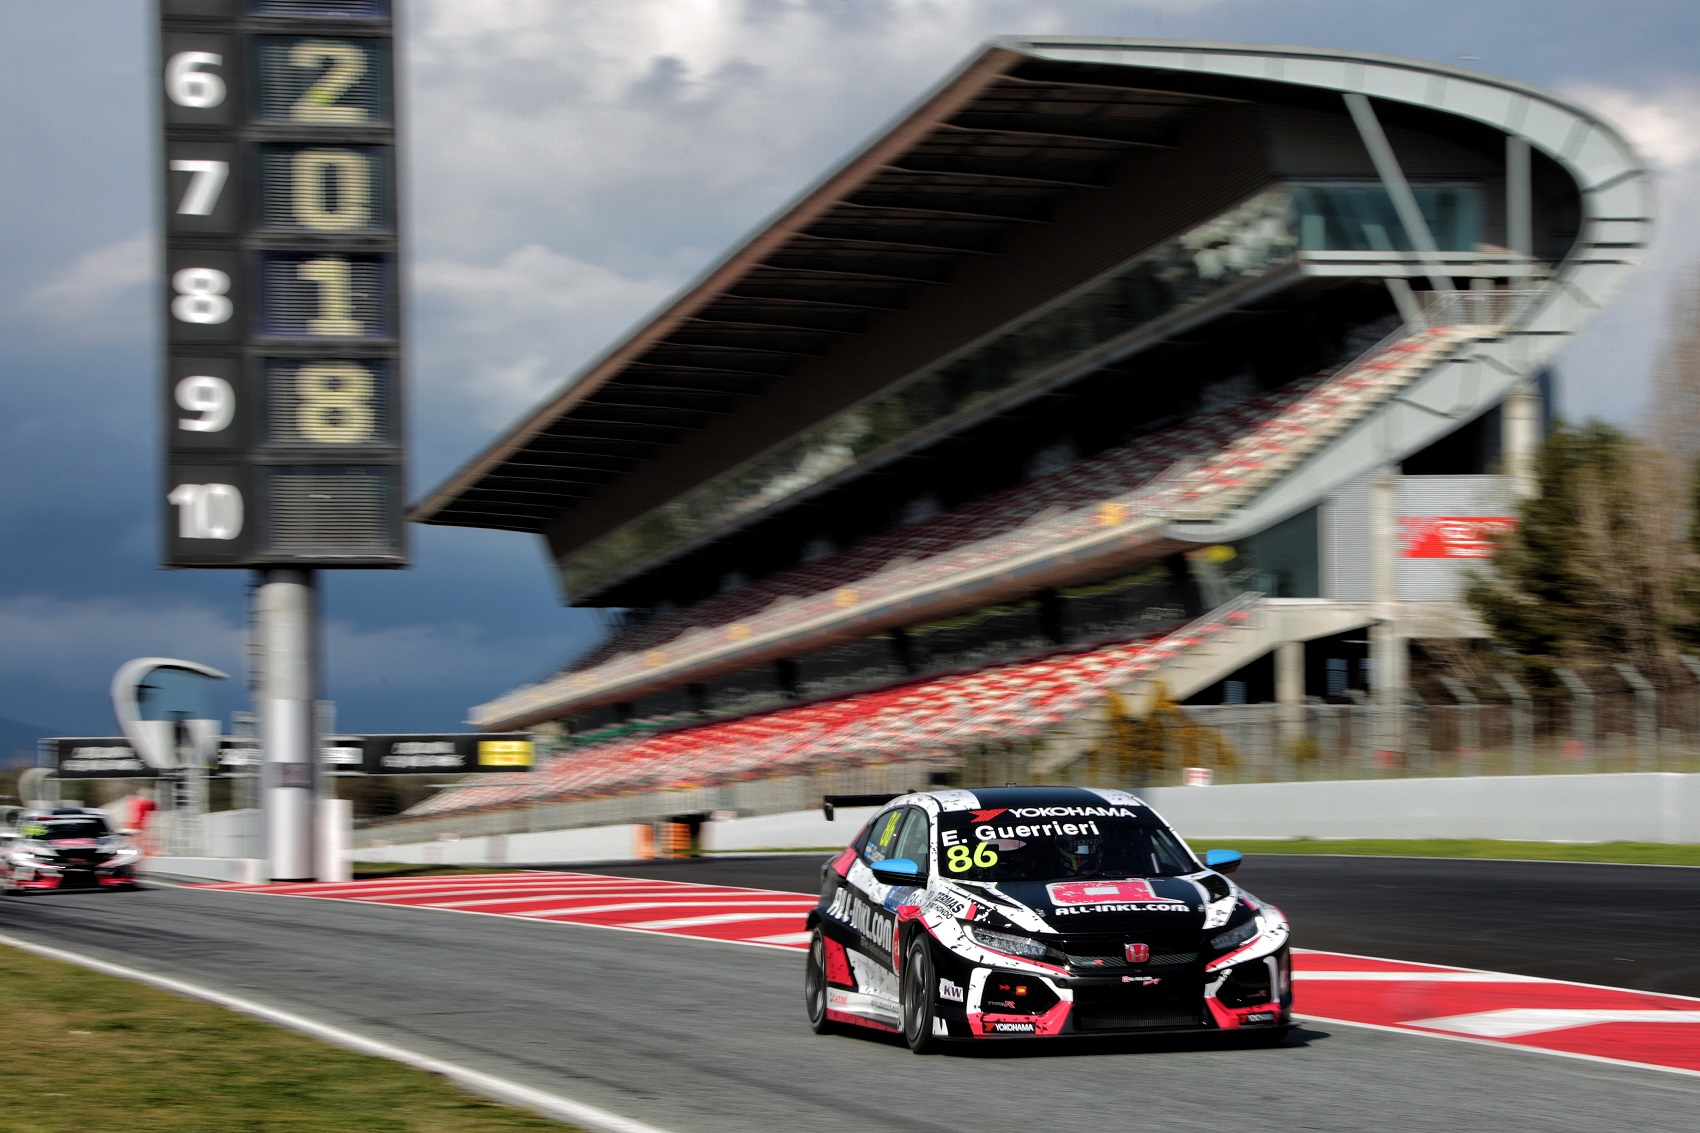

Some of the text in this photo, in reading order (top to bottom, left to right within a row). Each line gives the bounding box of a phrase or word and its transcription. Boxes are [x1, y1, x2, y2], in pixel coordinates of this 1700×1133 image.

[164, 41, 367, 122] 6 2
[169, 148, 370, 230] 7 0
[170, 259, 363, 336] 8 1
[174, 360, 375, 443] 9 8
[166, 483, 244, 540] 10
[941, 820, 1100, 847] E. Guerrieri
[1008, 806, 1137, 818] YOKOHAMA
[946, 841, 998, 873] 86
[943, 985, 961, 998] KW
[995, 1022, 1034, 1032] YOKOHAMA
